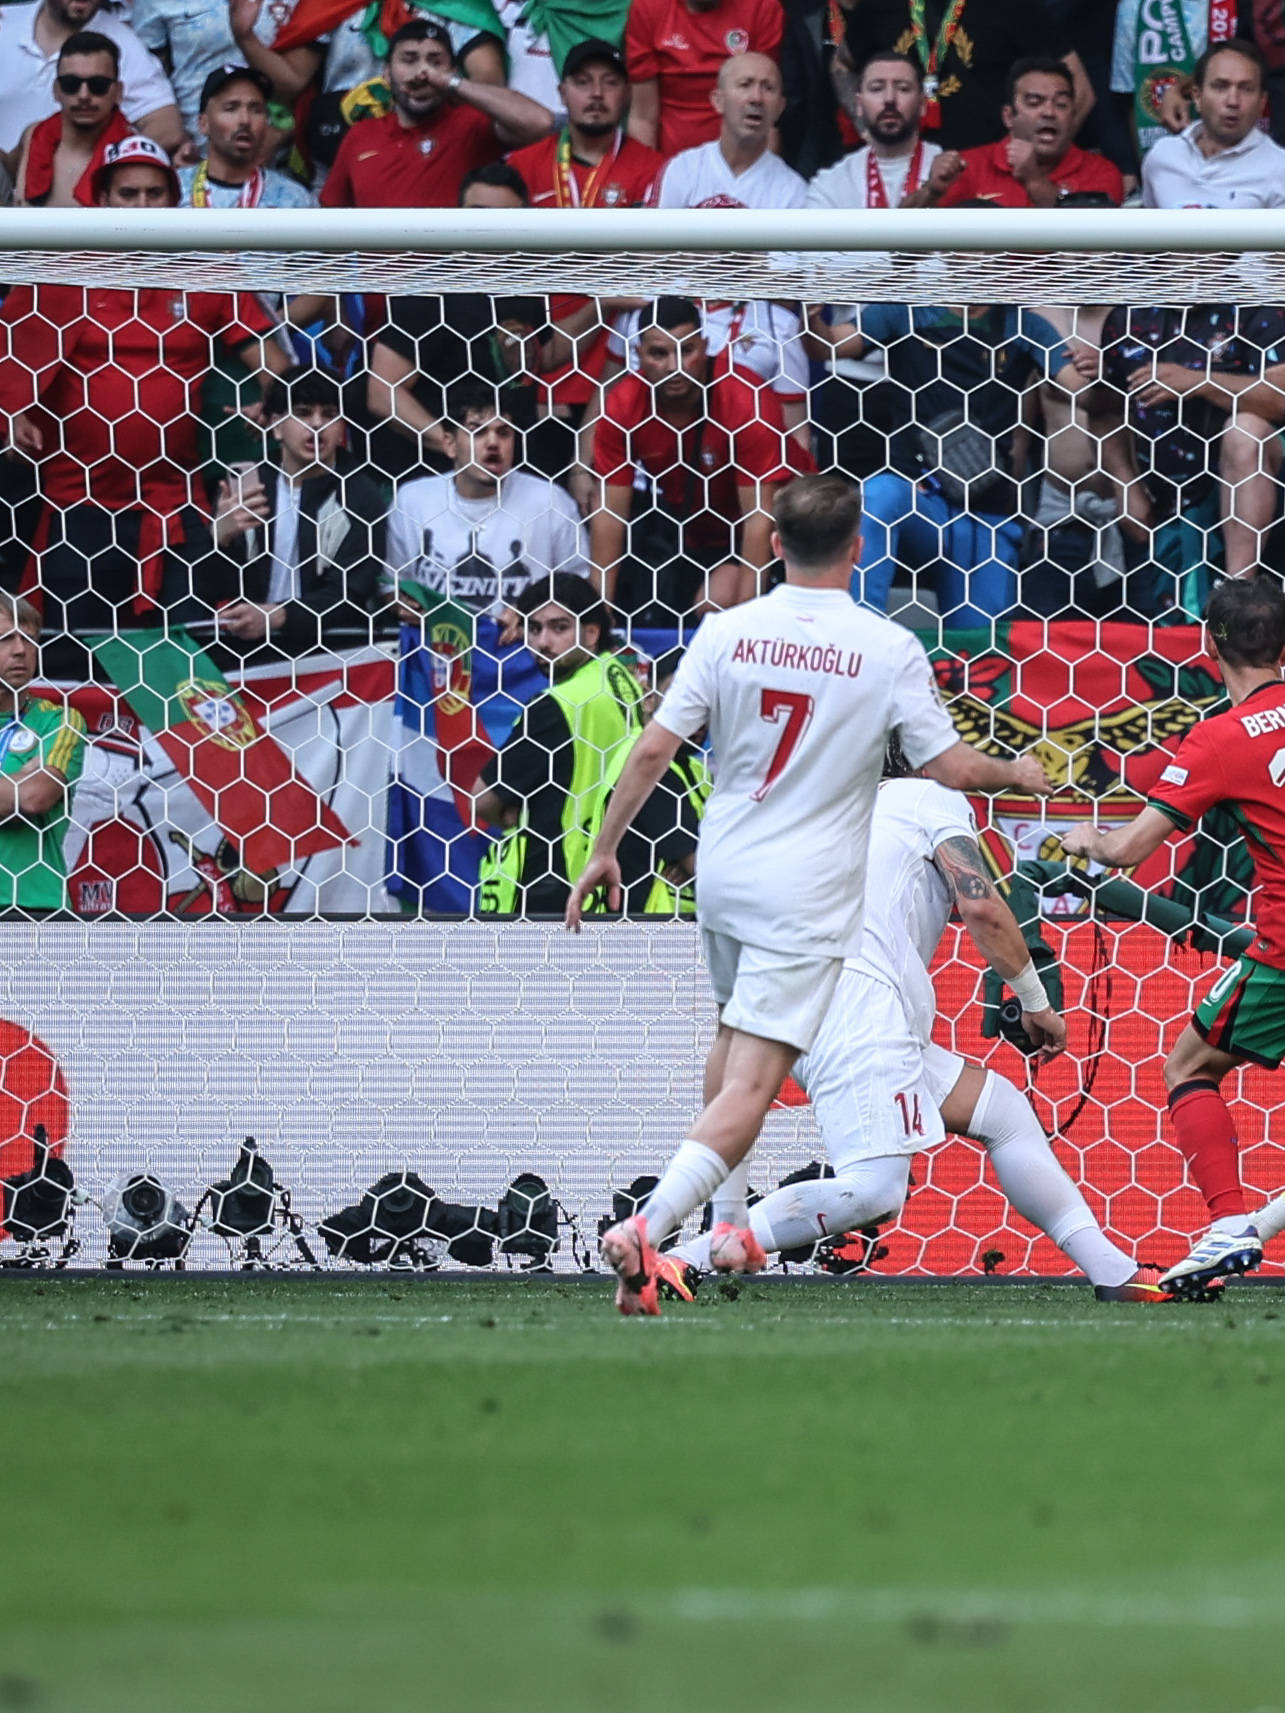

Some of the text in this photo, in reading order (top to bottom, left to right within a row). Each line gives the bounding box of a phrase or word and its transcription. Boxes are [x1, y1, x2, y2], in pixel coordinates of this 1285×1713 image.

[732, 637, 862, 678] AKTÜRKOĞLU
[751, 688, 815, 803] 7
[894, 1092, 927, 1137] 14
